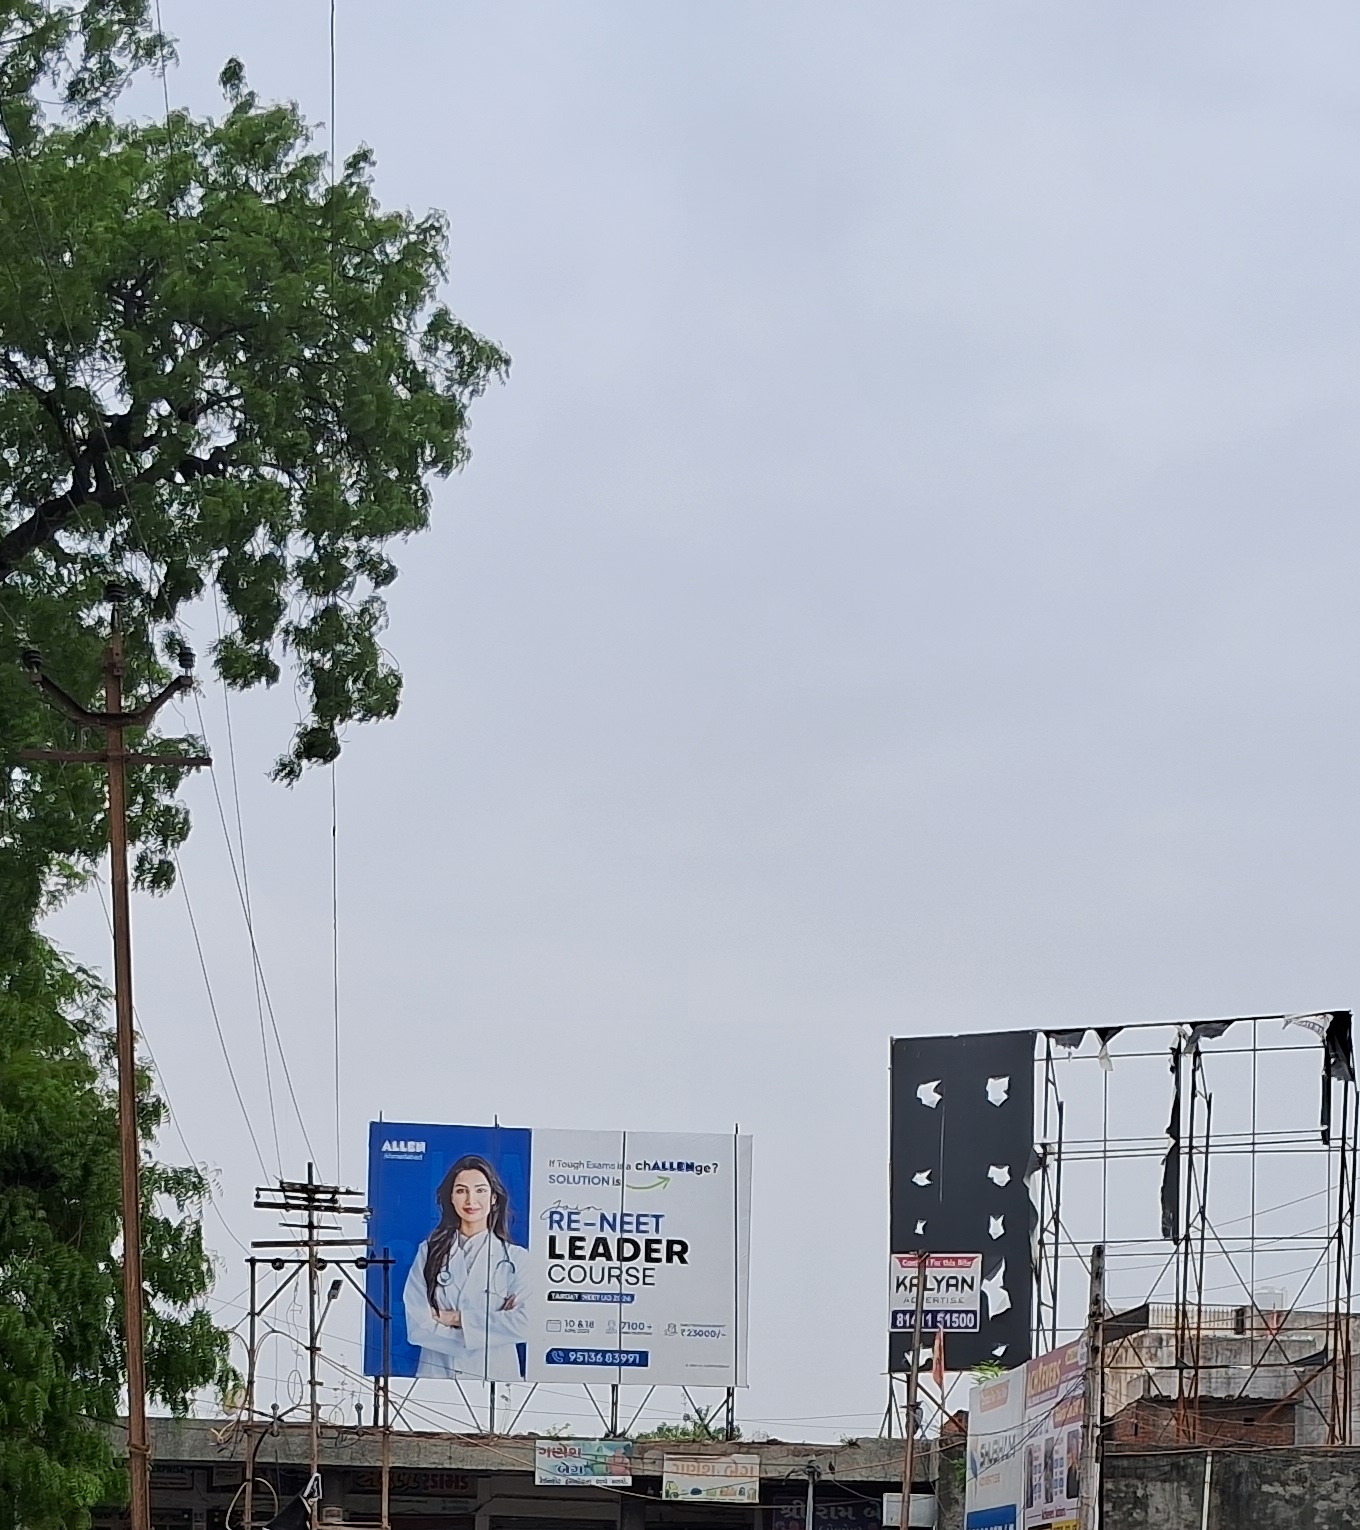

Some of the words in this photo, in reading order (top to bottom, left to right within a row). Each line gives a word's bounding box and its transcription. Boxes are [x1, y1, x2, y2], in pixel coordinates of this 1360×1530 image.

[382, 1140, 426, 1154] ALLEN
[557, 1159, 584, 1171] Tough
[586, 1160, 615, 1170] Exams
[549, 1174, 610, 1187] SOLUTION
[540, 1200, 603, 1221] Join
[548, 1211, 666, 1235] RE-NEET
[548, 1235, 690, 1265] LEADER
[548, 1264, 656, 1286] COURSE
[895, 1275, 975, 1294] KALYAN
[903, 1296, 966, 1304] ADERTISE
[564, 1320, 575, 1328] 10
[937, 1312, 975, 1328] 51500
[568, 1352, 603, 1364] 95136
[538, 1443, 582, 1459] ગણેશ
[556, 1461, 586, 1475] બેગ
[815, 1506, 857, 1521] રામ
